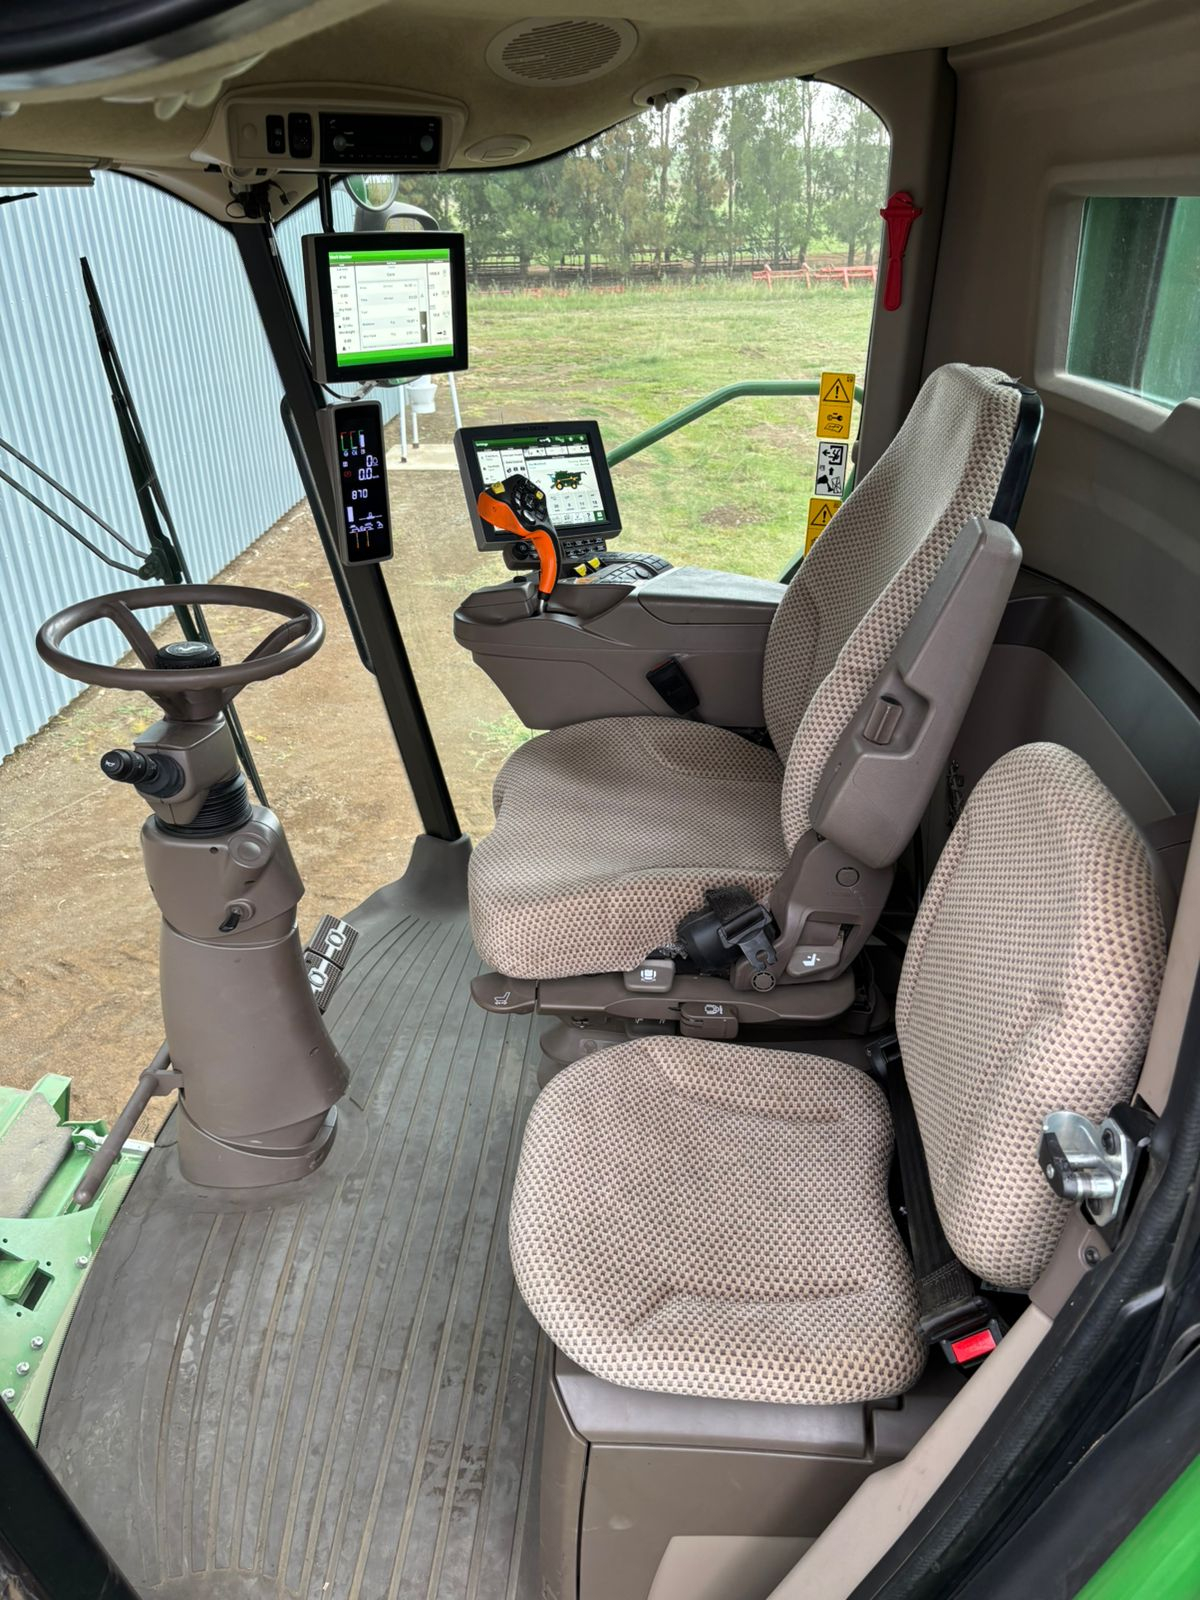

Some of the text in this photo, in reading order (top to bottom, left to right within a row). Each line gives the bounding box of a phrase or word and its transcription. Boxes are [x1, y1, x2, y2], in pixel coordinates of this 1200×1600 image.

[366, 455, 372, 467] 0
[358, 468, 372, 481] 0.0
[351, 489, 368, 500] 870
